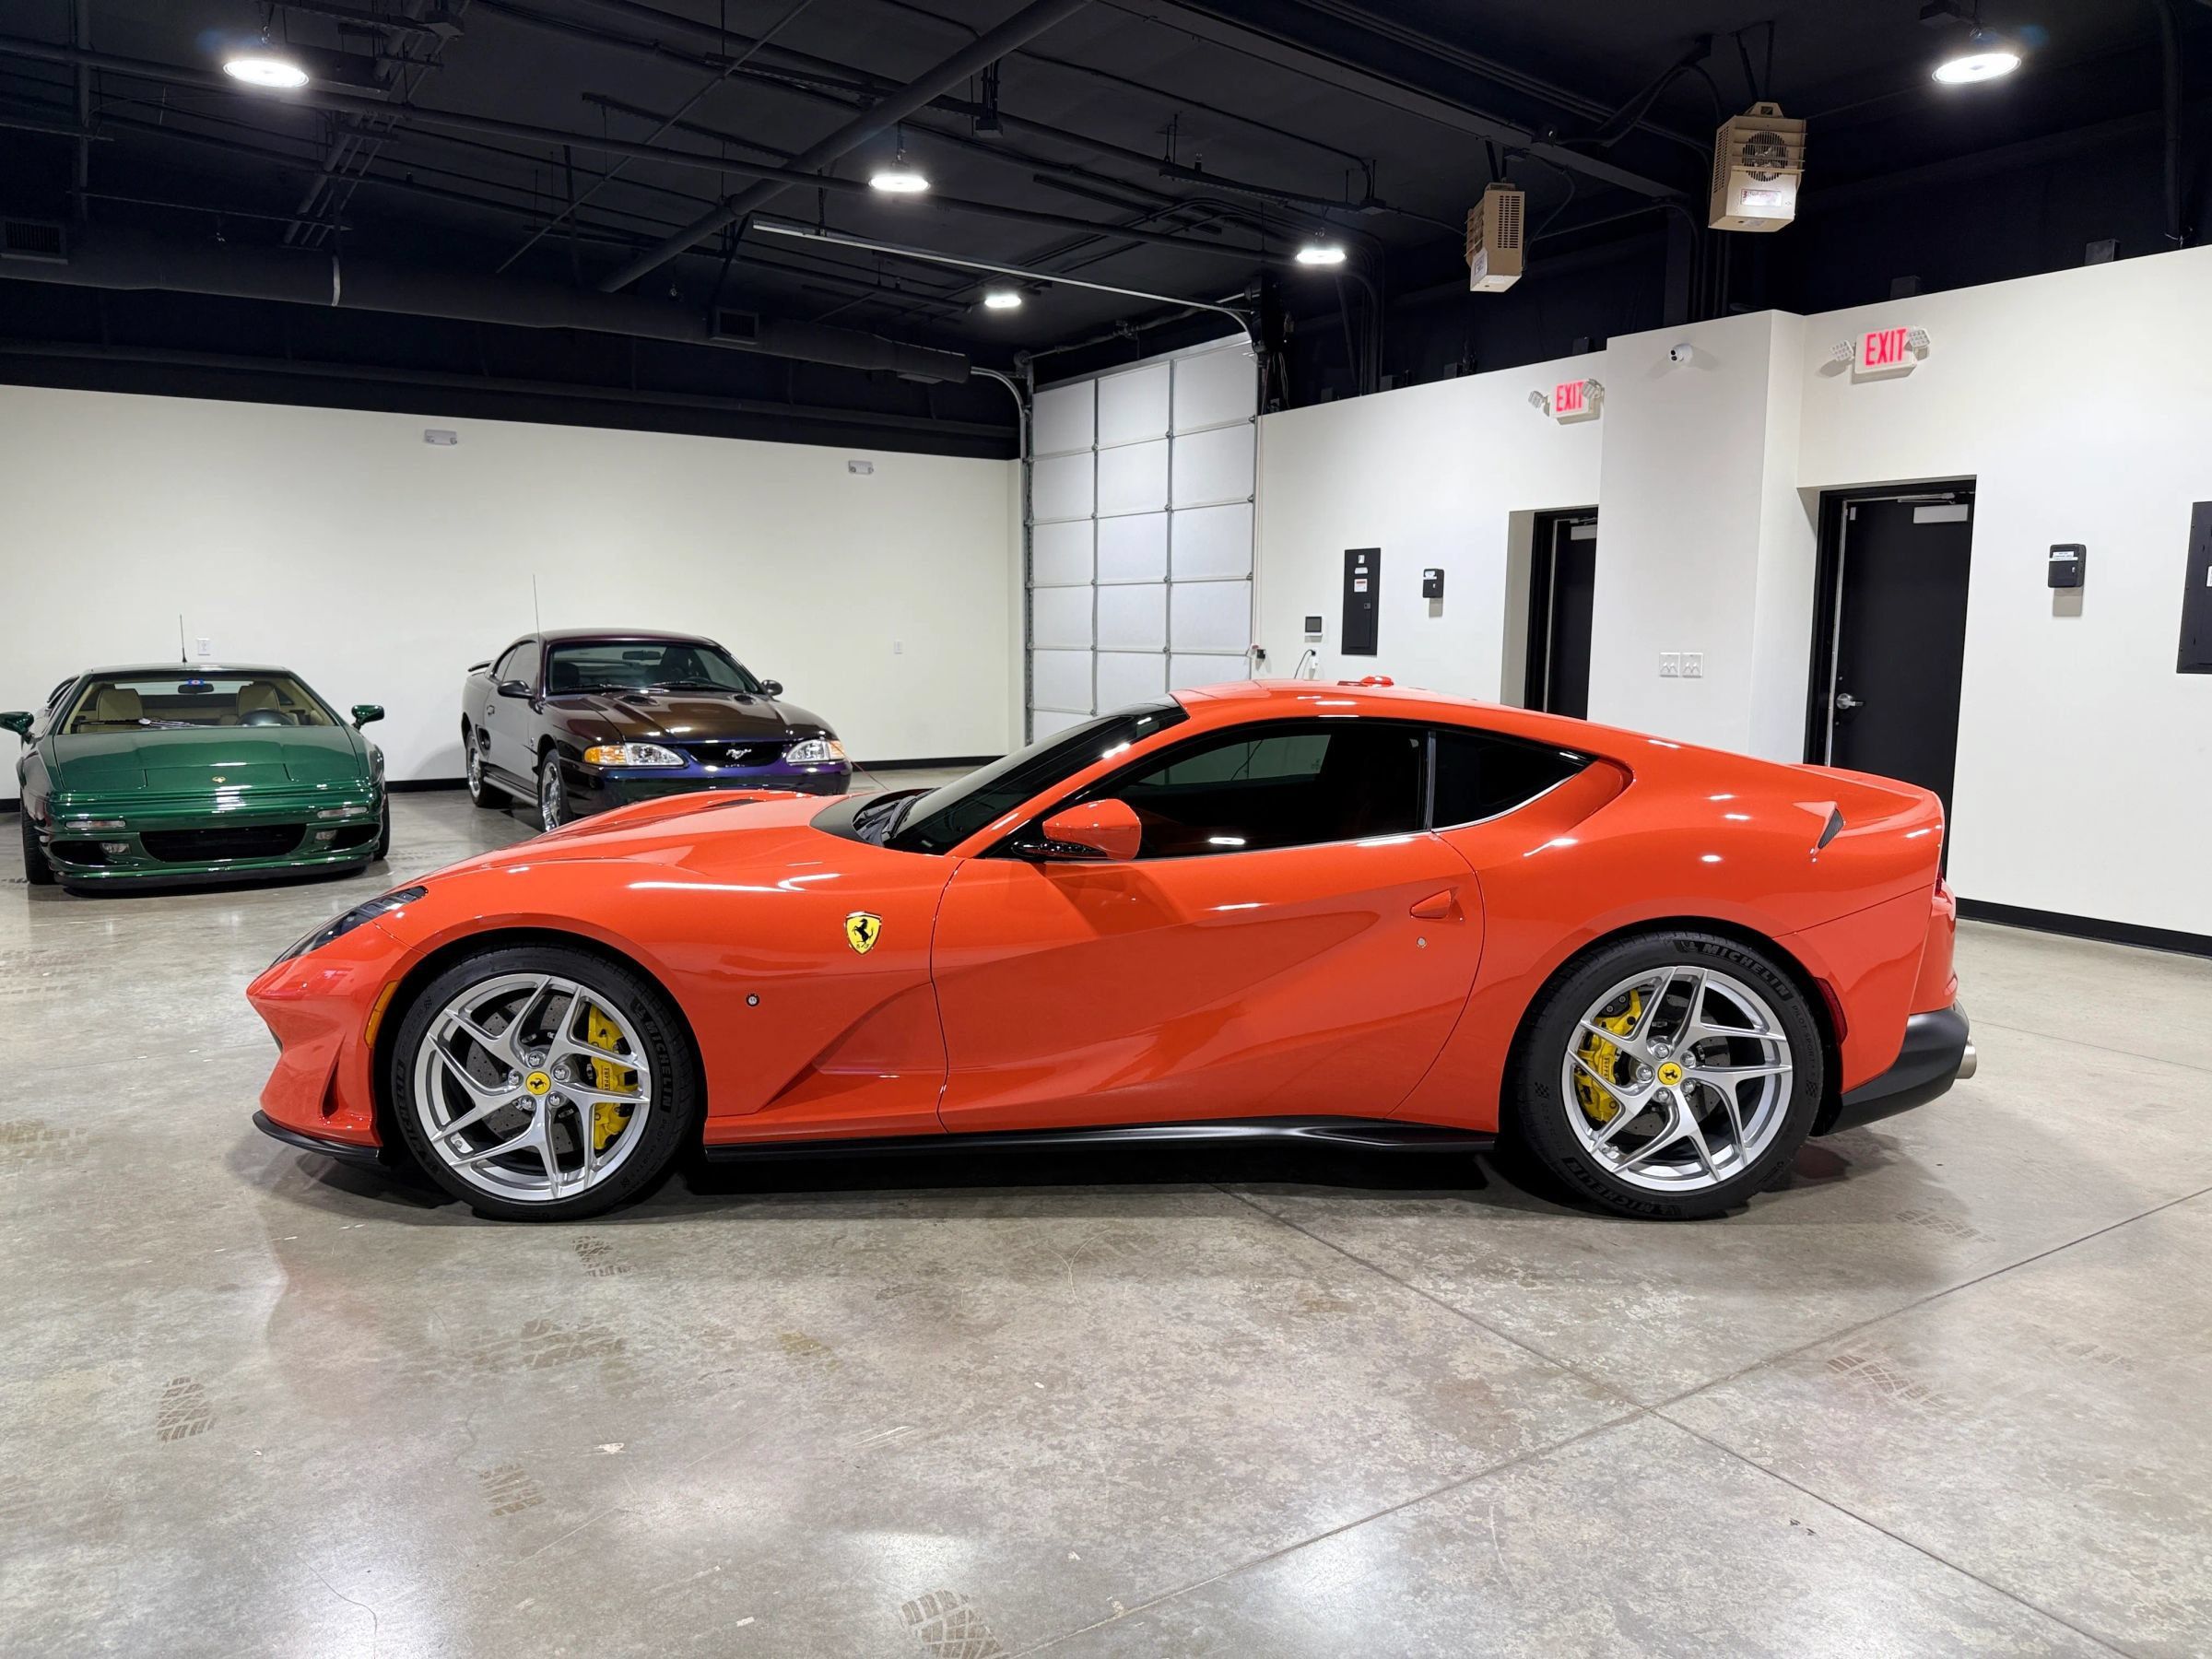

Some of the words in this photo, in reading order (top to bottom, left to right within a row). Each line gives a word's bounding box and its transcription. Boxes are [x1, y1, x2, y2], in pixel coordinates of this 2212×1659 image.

[1865, 328, 1907, 366] EXIT
[1556, 381, 1584, 412] EXIT
[1701, 943, 1791, 997] MICHELIN
[645, 1020, 673, 1108] MICHELIN
